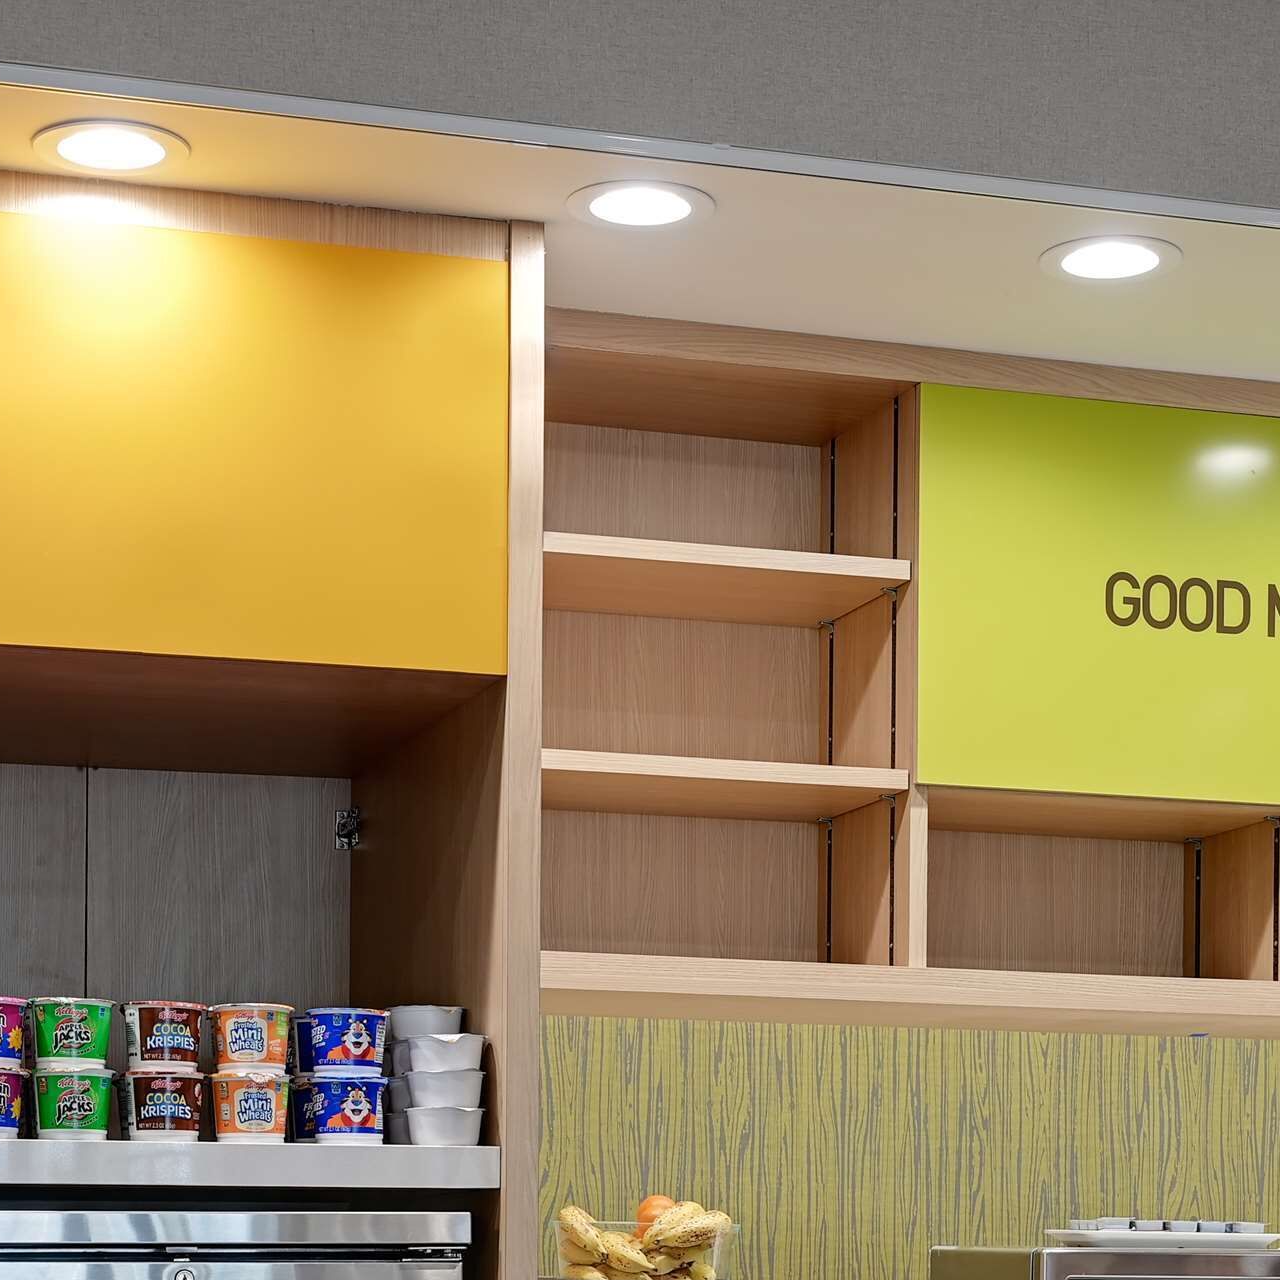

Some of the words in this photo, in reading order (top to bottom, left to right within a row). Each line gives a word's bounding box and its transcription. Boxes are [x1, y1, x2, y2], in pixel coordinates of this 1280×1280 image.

[1105, 571, 1251, 635] GOOD
[59, 1023, 82, 1031] APPLE
[153, 1023, 191, 1037] COCOA
[234, 1021, 258, 1029] Frosted
[53, 1029, 91, 1053] JACKS
[231, 1028, 262, 1041] Mini
[146, 1036, 195, 1051] KRISPIES
[229, 1039, 264, 1053] Wheats
[63, 1095, 86, 1103] APPLE
[146, 1092, 187, 1105] COCOA
[243, 1091, 267, 1099] Frosted
[140, 1105, 192, 1119] KRISPIES
[240, 1098, 272, 1112] Mini
[56, 1101, 93, 1124] JACKS
[238, 1109, 273, 1123] Wheats
